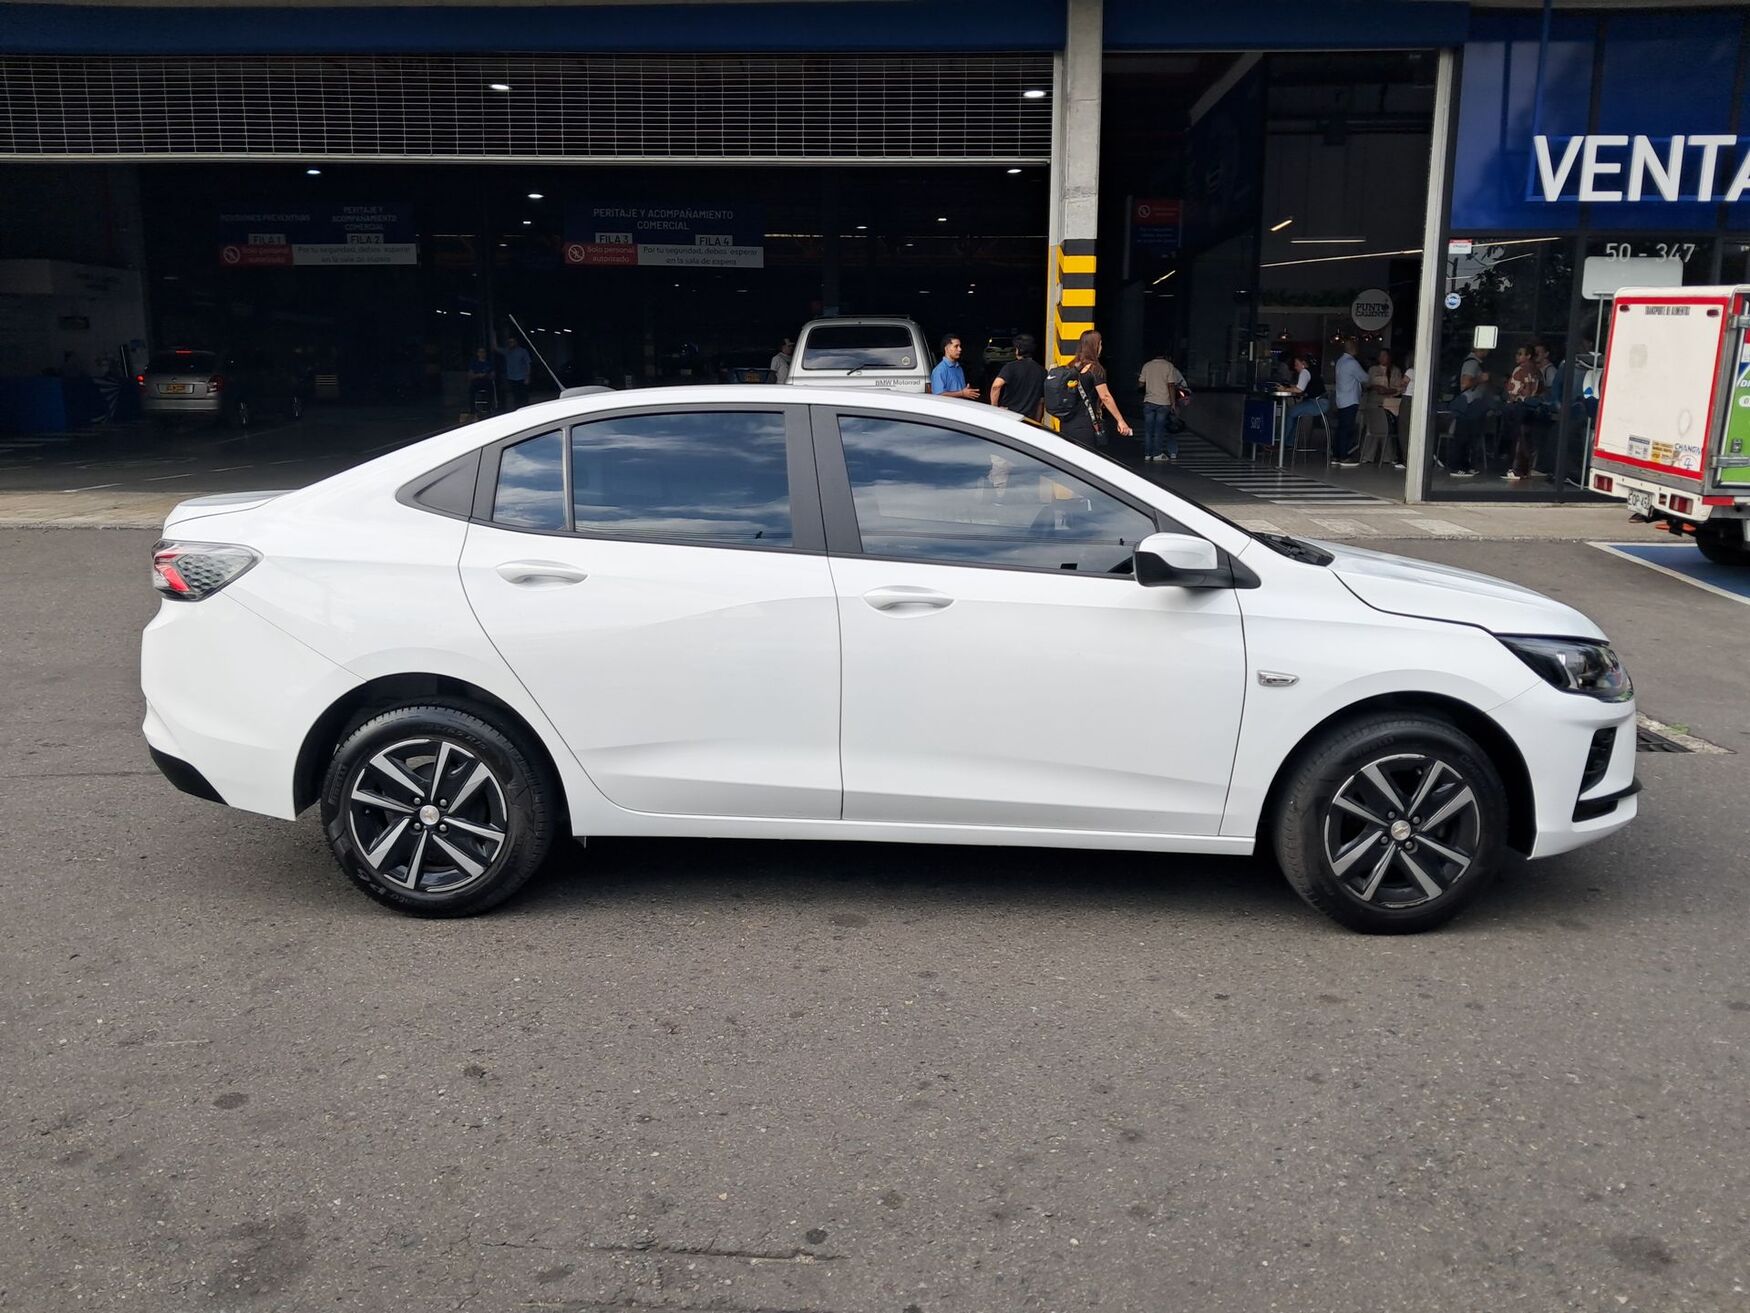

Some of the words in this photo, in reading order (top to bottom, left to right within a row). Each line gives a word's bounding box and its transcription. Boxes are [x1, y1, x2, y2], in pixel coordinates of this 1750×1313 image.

[592, 208, 637, 218] PERITAJE
[639, 208, 646, 218] Y
[647, 207, 735, 220] ACOMPAÑAMIENTO
[636, 220, 690, 231] COMERCIAL
[351, 235, 372, 244] FILA
[599, 234, 621, 244] FILA
[623, 234, 629, 244] 3
[699, 236, 720, 246] FILA
[723, 237, 729, 246] 4
[1605, 243, 1632, 262] 50
[1655, 243, 1696, 263] 347
[1355, 302, 1389, 311] PUNTO
[875, 379, 892, 387] BMW
[892, 378, 921, 386] Motorrad
